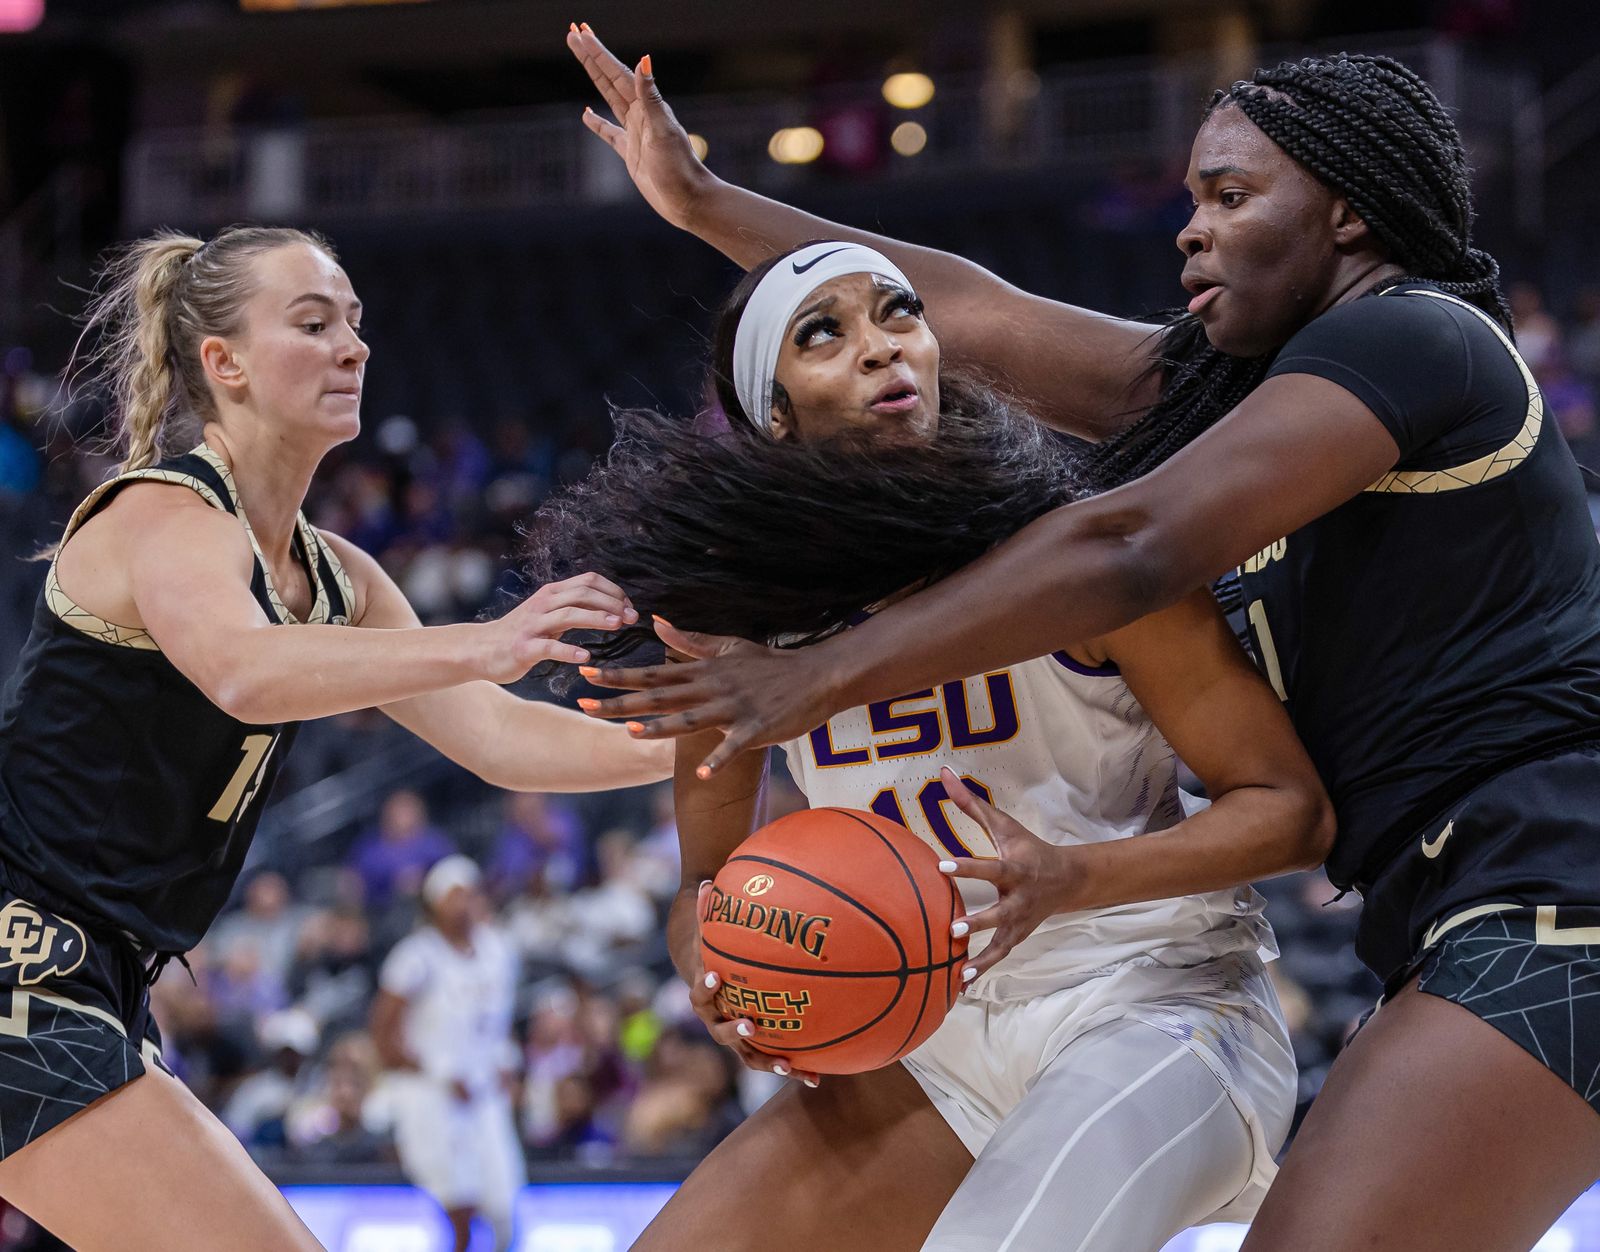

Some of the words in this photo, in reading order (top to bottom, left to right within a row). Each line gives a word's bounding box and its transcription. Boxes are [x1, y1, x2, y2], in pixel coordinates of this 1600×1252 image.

[808, 669, 1021, 769] LSU
[206, 732, 281, 823] 1
[0, 906, 58, 963] CU
[719, 981, 812, 1016] GACY
